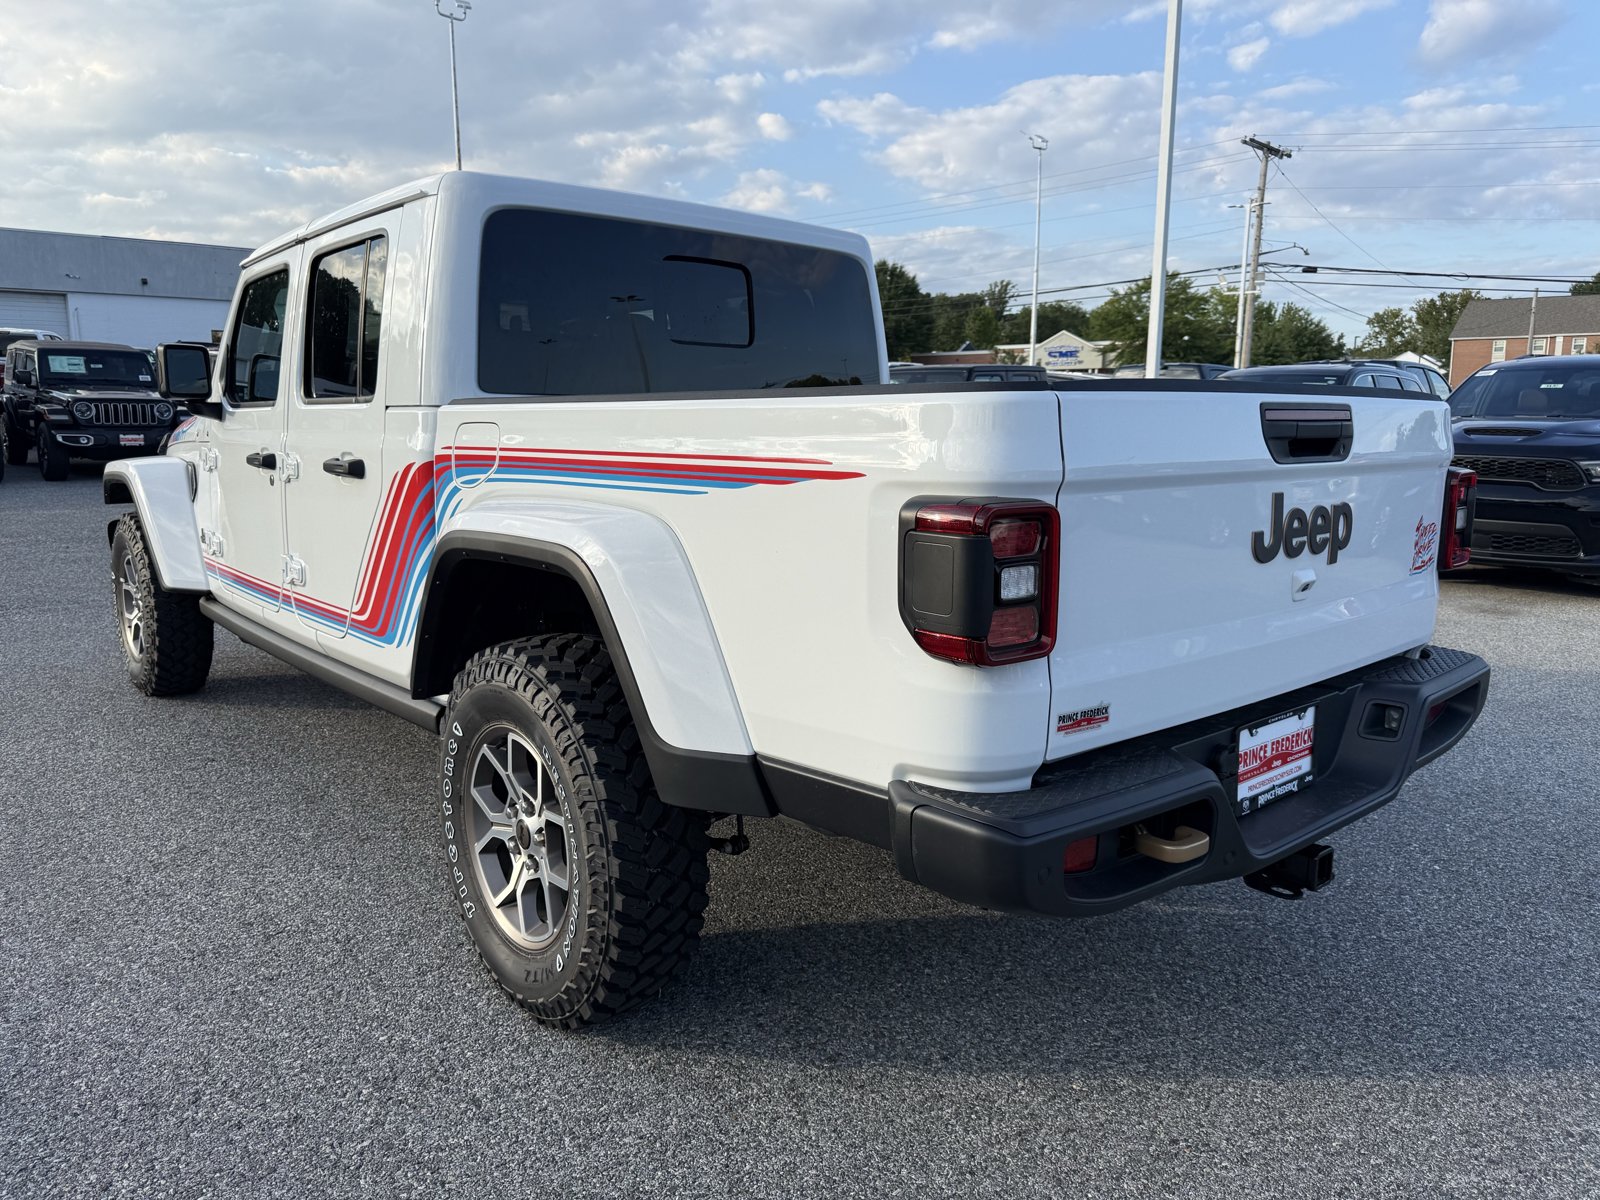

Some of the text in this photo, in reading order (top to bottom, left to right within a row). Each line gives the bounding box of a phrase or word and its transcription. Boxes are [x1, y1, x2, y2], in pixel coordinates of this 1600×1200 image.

[1251, 492, 1353, 565] Jeep
[1058, 712, 1079, 724] PRINCE
[1080, 706, 1109, 718] FREDERICK
[1268, 712, 1294, 723] CHRYSLER
[1239, 728, 1313, 768] PRINCE FREDERICK
[1240, 749, 1310, 781] CHRYSLER Jeep DODGE
[1304, 775, 1313, 783] Jeep
[1258, 780, 1298, 808] PRINCE FREDERICK
[542, 745, 580, 959] DESTINATION
